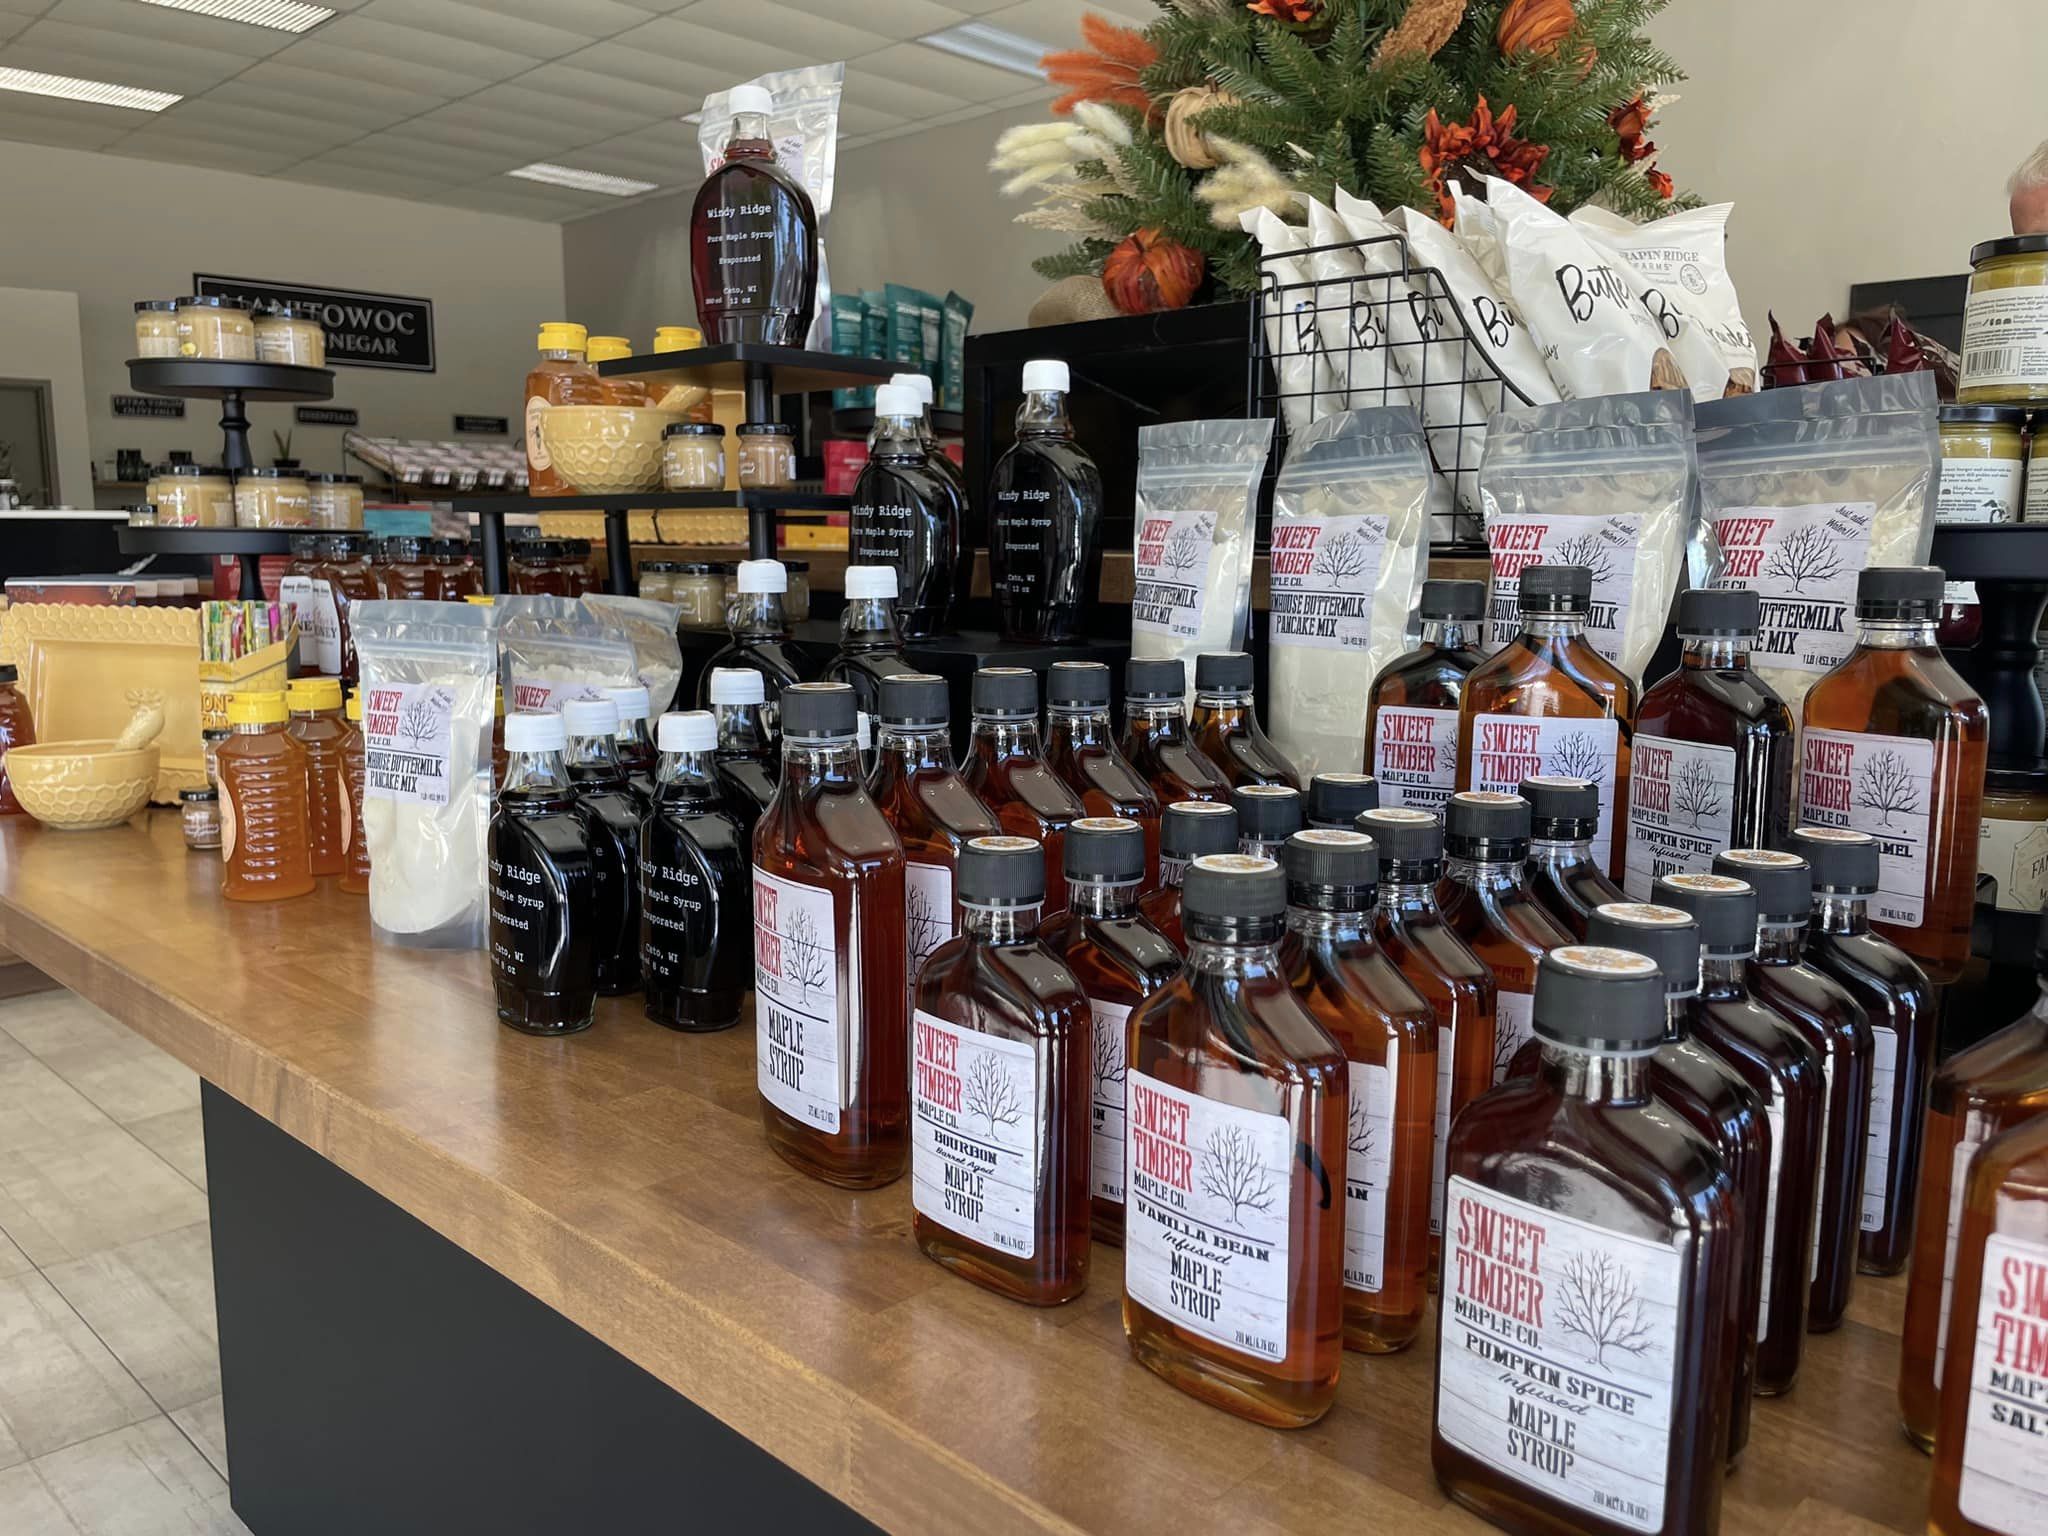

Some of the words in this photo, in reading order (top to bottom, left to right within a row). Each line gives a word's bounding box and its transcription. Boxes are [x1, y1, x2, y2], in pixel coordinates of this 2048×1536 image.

[707, 206, 736, 218] Windy
[740, 204, 772, 216] Ridge
[750, 231, 774, 240] Syrup
[1664, 252, 1699, 263] RIDGE
[328, 332, 400, 356] NEGAR
[1023, 490, 1050, 502] Ridge
[879, 504, 912, 519] Ridge
[1031, 518, 1052, 528] Syrup
[889, 528, 914, 538] Syrup
[1272, 526, 1321, 550] SWEET
[1488, 524, 1548, 550] SWEET
[1272, 552, 1314, 575] IMBER
[1491, 553, 1543, 578] MBER
[1724, 550, 1766, 578] BER
[1290, 578, 1304, 586] CO.
[1152, 584, 1198, 609] BUTTERMILK
[1303, 595, 1366, 618] BUTTERMILK
[1158, 606, 1173, 624] MIX
[1276, 615, 1314, 636] PANCAKE
[1316, 618, 1338, 638] MIX
[1759, 602, 1848, 633] UTTERMILK
[1768, 632, 1800, 655] MIX
[368, 690, 402, 713] SWEET
[515, 684, 552, 708] SWEET
[368, 713, 398, 736] IMBER
[1383, 714, 1434, 743] SWEET
[1482, 722, 1540, 754] SWEET
[391, 754, 443, 777] BUTTERMILK
[1382, 742, 1436, 772] TIMBER
[1480, 754, 1542, 784] TIMBER
[1634, 744, 1672, 780] SWEET
[1804, 739, 1855, 776] SWEET
[370, 770, 400, 790] PANCAKE
[400, 776, 418, 794] MIX
[1382, 770, 1415, 782] MAPLE
[1416, 773, 1431, 784] CO.
[1480, 783, 1518, 794] MAPLE
[1633, 776, 1670, 813] TIMBER
[1803, 773, 1852, 812] TIMBER
[1632, 806, 1656, 824] MAPLE
[1657, 814, 1670, 826] CO.
[1802, 806, 1833, 824] MAPLE
[1834, 812, 1851, 828] CO.
[1635, 826, 1678, 848] PUMPKIN
[1680, 838, 1712, 855] SPICE
[1648, 844, 1692, 862] Infused
[507, 864, 541, 885] Ridge
[662, 866, 699, 886] Ridge
[1652, 859, 1684, 878] MAPLE
[496, 885, 514, 902] Maple
[518, 894, 544, 911] Syrup
[648, 887, 670, 903] Maple
[674, 895, 702, 912] Syrup
[492, 907, 529, 931] Evaporated
[643, 908, 685, 932] Evaporated
[495, 942, 511, 960] Cato,
[514, 951, 524, 962] WI
[646, 943, 664, 960] Cato,
[668, 952, 679, 964] WI
[508, 964, 516, 975] oz
[660, 966, 670, 976] oz
[768, 1006, 804, 1057] MAPLE
[916, 1020, 959, 1072] SWEET
[769, 1042, 804, 1092] SYRUP
[916, 1063, 962, 1114] TIMBER
[918, 1099, 944, 1126] MAPLE
[944, 1111, 959, 1130] CO.
[1134, 1083, 1190, 1147] SWEET
[934, 1130, 998, 1166] BOURBON
[936, 1146, 967, 1167] Barrel
[967, 1160, 994, 1176] Aged
[1133, 1128, 1193, 1193] TIMBER
[944, 1162, 984, 1200] MAPLE
[1134, 1171, 1168, 1202] MAPLE
[1170, 1188, 1188, 1210] CO.
[944, 1188, 984, 1224] SYRUP
[1136, 1199, 1208, 1244] VANILLA
[1212, 1234, 1270, 1263] BEAN
[1457, 1197, 1546, 1276] SWEET
[1162, 1230, 1232, 1266] Infused
[1170, 1252, 1222, 1296] MAPLE
[1170, 1280, 1221, 1323] SYRUP
[1456, 1249, 1544, 1329] TIMBER
[1999, 1256, 2048, 1321] SW
[1454, 1296, 1512, 1337] MAPLE
[1516, 1322, 1543, 1352] CO.
[1993, 1311, 2048, 1379] TIM
[1466, 1330, 1560, 1390] PUMPKIN
[1566, 1376, 1636, 1416] SPICE
[1990, 1368, 2048, 1402] MAP
[1498, 1371, 1590, 1417] Infused
[1507, 1396, 1577, 1451] MAPLE
[1991, 1402, 2048, 1436] SAL
[1507, 1428, 1575, 1480] SYRUP
